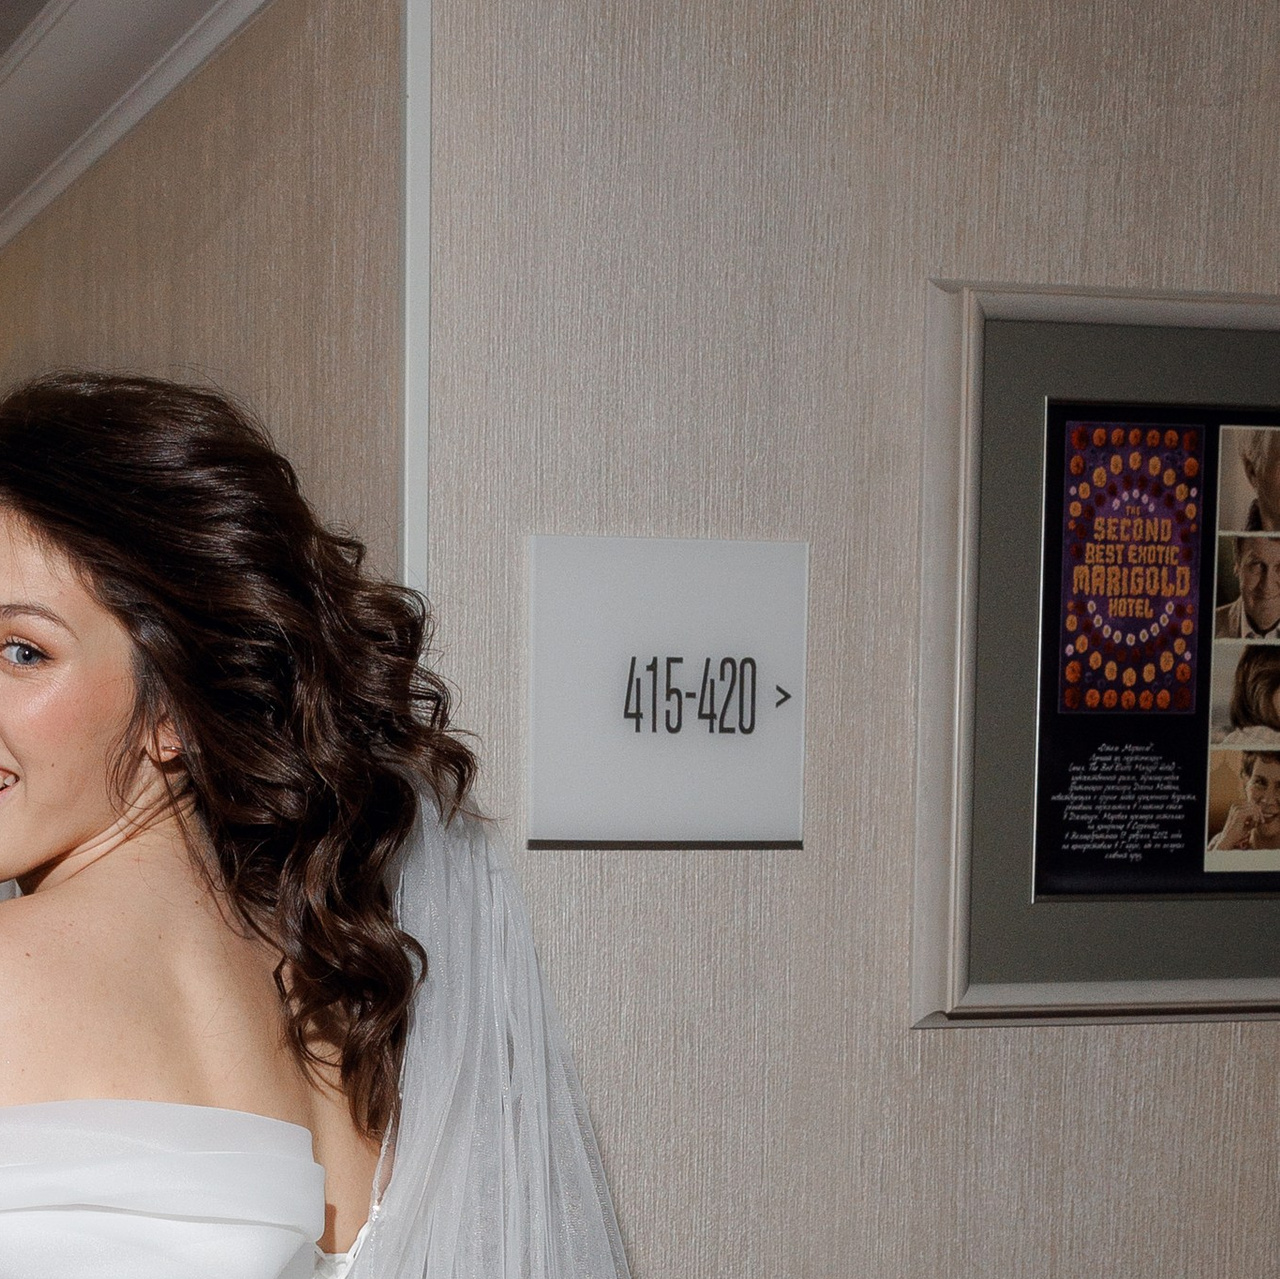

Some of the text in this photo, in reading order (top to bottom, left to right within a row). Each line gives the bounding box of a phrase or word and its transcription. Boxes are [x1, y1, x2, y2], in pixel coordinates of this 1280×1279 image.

[1125, 505, 1141, 516] THE
[1093, 516, 1172, 542] SECOND
[1084, 542, 1180, 566] BEST EXOTIC
[1072, 565, 1191, 597] MARIGOLD
[1107, 598, 1154, 618] HOTEL
[623, 655, 758, 735] 415-420
